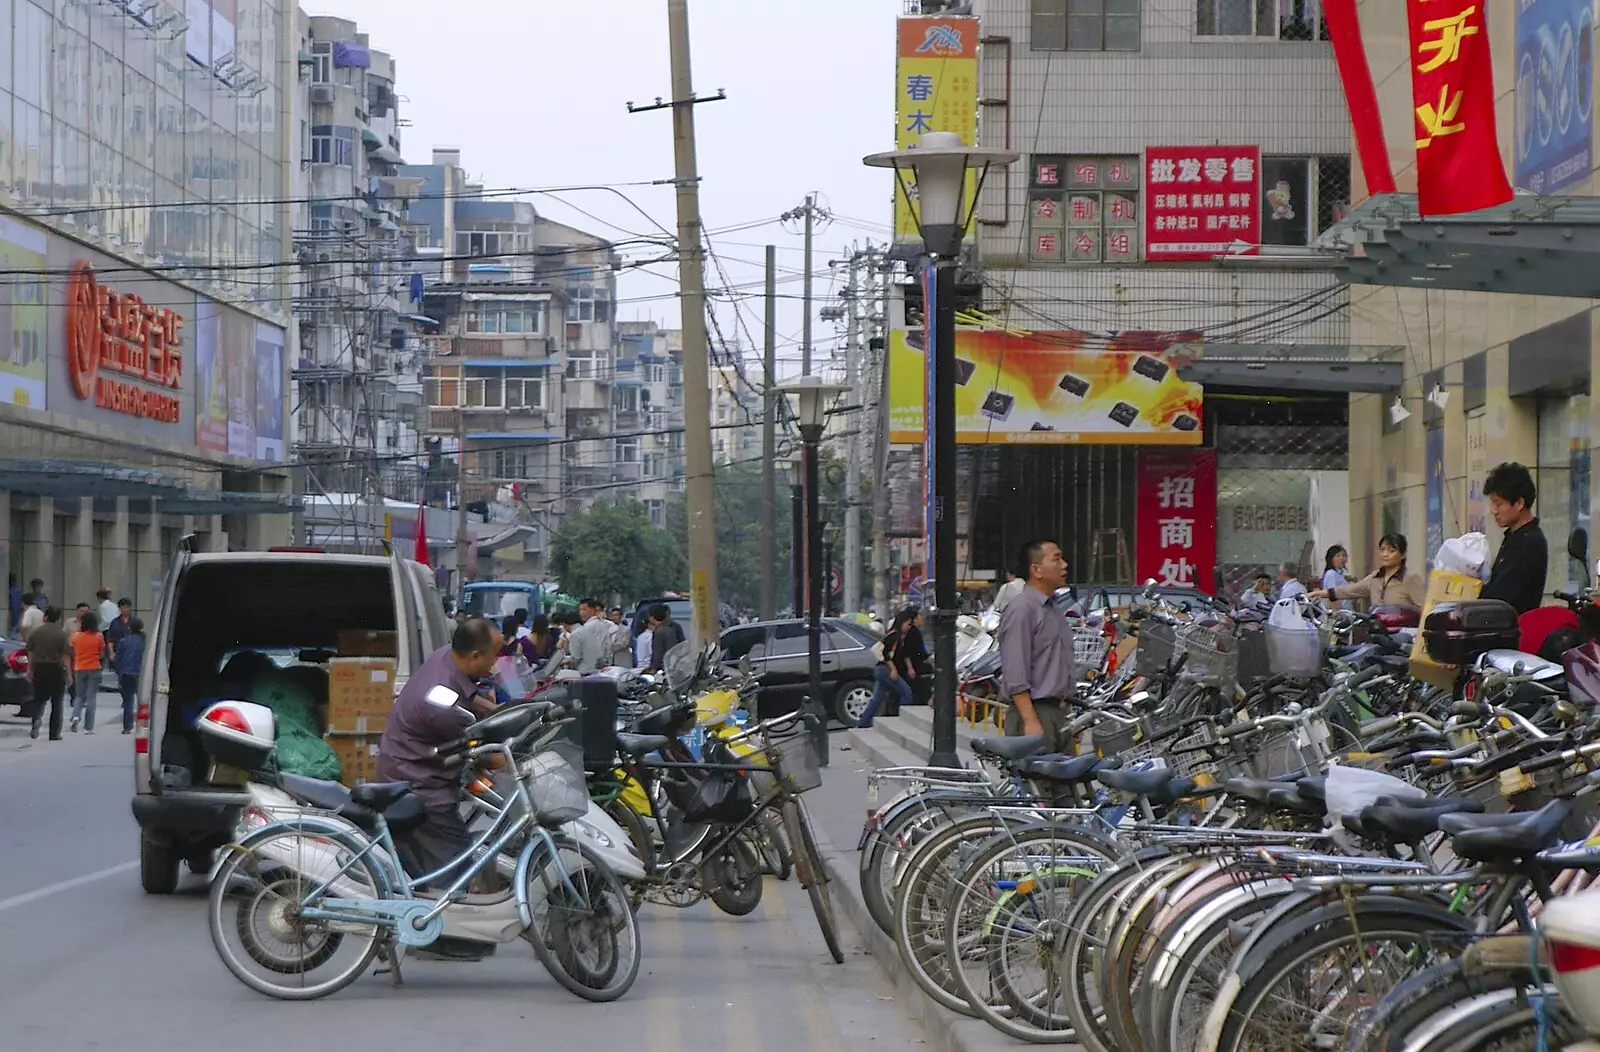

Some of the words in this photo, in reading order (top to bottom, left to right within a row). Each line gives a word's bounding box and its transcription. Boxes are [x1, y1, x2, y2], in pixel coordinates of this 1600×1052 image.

[1416, 5, 1479, 149] 开业
[1036, 160, 1131, 185] 压缩机
[1150, 158, 1255, 183] 批发零售
[1154, 194, 1188, 208] 压缩机
[1155, 215, 1198, 230] 各种进口
[1206, 215, 1252, 230] 国产配件
[1157, 476, 1196, 588] 招商处
